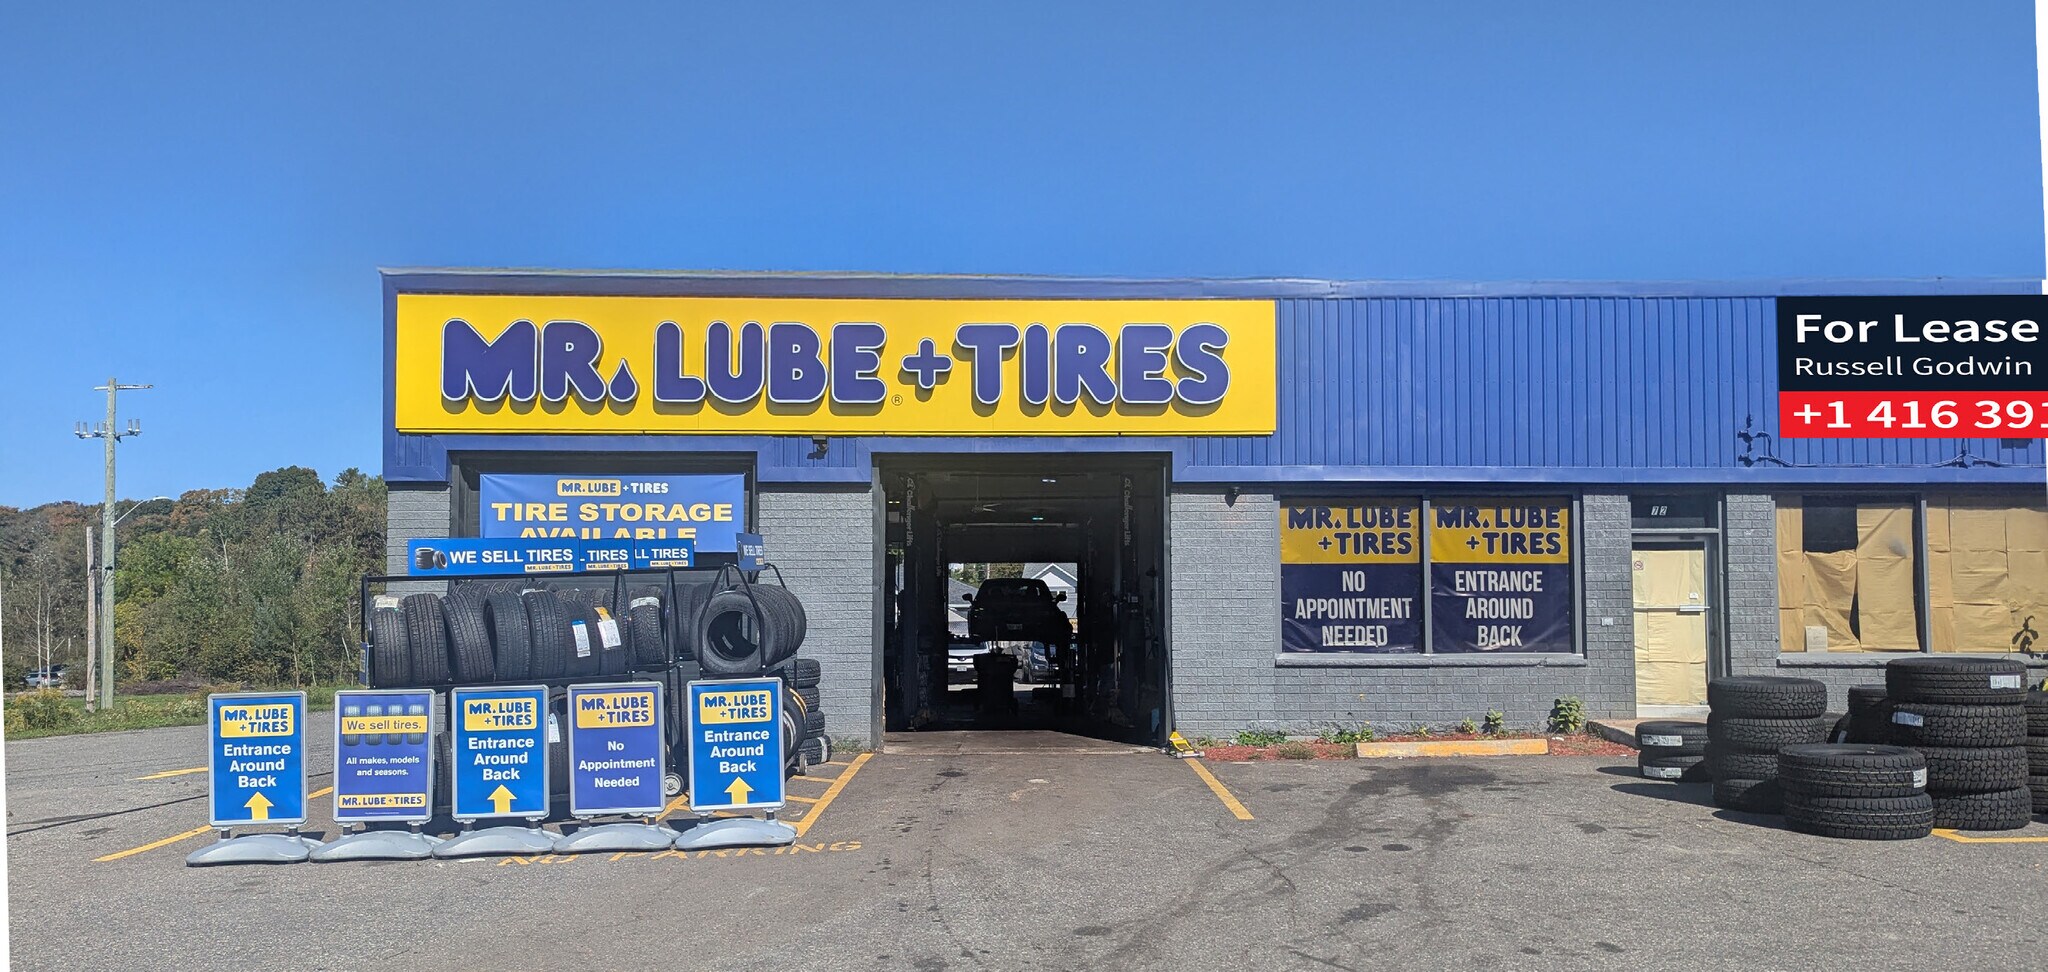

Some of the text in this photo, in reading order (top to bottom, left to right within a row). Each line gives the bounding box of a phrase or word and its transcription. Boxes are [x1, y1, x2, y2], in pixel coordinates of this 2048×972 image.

[1796, 314, 2040, 343] For Lease
[440, 318, 638, 402] MR.
[653, 319, 888, 403] LUBE
[1795, 356, 2032, 376] Russell Godwin
[1793, 400, 2048, 429] +1 416 39
[587, 482, 617, 493] LUBE
[491, 502, 733, 521] TIRE STORAGE
[1346, 505, 1413, 529] LUBE
[1495, 505, 1560, 529] LUBE
[450, 549, 573, 564] WE SELL TIRES
[587, 549, 628, 561] TIRES
[651, 548, 688, 559] TIRES
[1342, 570, 1366, 592] NO
[1455, 570, 1543, 592] ENTRANCE
[1295, 598, 1412, 619] APPOINTMENT
[1465, 597, 1534, 619] AROUND
[1322, 625, 1388, 647] NEEDED
[1477, 625, 1522, 647] BACK
[613, 696, 649, 709] LUBE
[734, 694, 767, 706] LUBE
[255, 708, 288, 720] LUBE
[499, 702, 532, 713] LUBE
[347, 720, 421, 730] We sell tires.
[704, 730, 770, 743] Entrance
[223, 744, 292, 756] Entrance
[468, 738, 535, 750] Entrance
[607, 741, 624, 751] No
[710, 744, 764, 758] Around
[346, 756, 420, 765] All makes, models
[474, 751, 528, 765] Around
[579, 757, 656, 772] Appointment
[229, 758, 285, 772] Around
[719, 760, 757, 773] Back
[357, 768, 372, 776] and
[483, 768, 520, 780] Back
[238, 775, 277, 788] Back
[594, 776, 640, 788] Needed
[363, 797, 386, 805] LUBE
